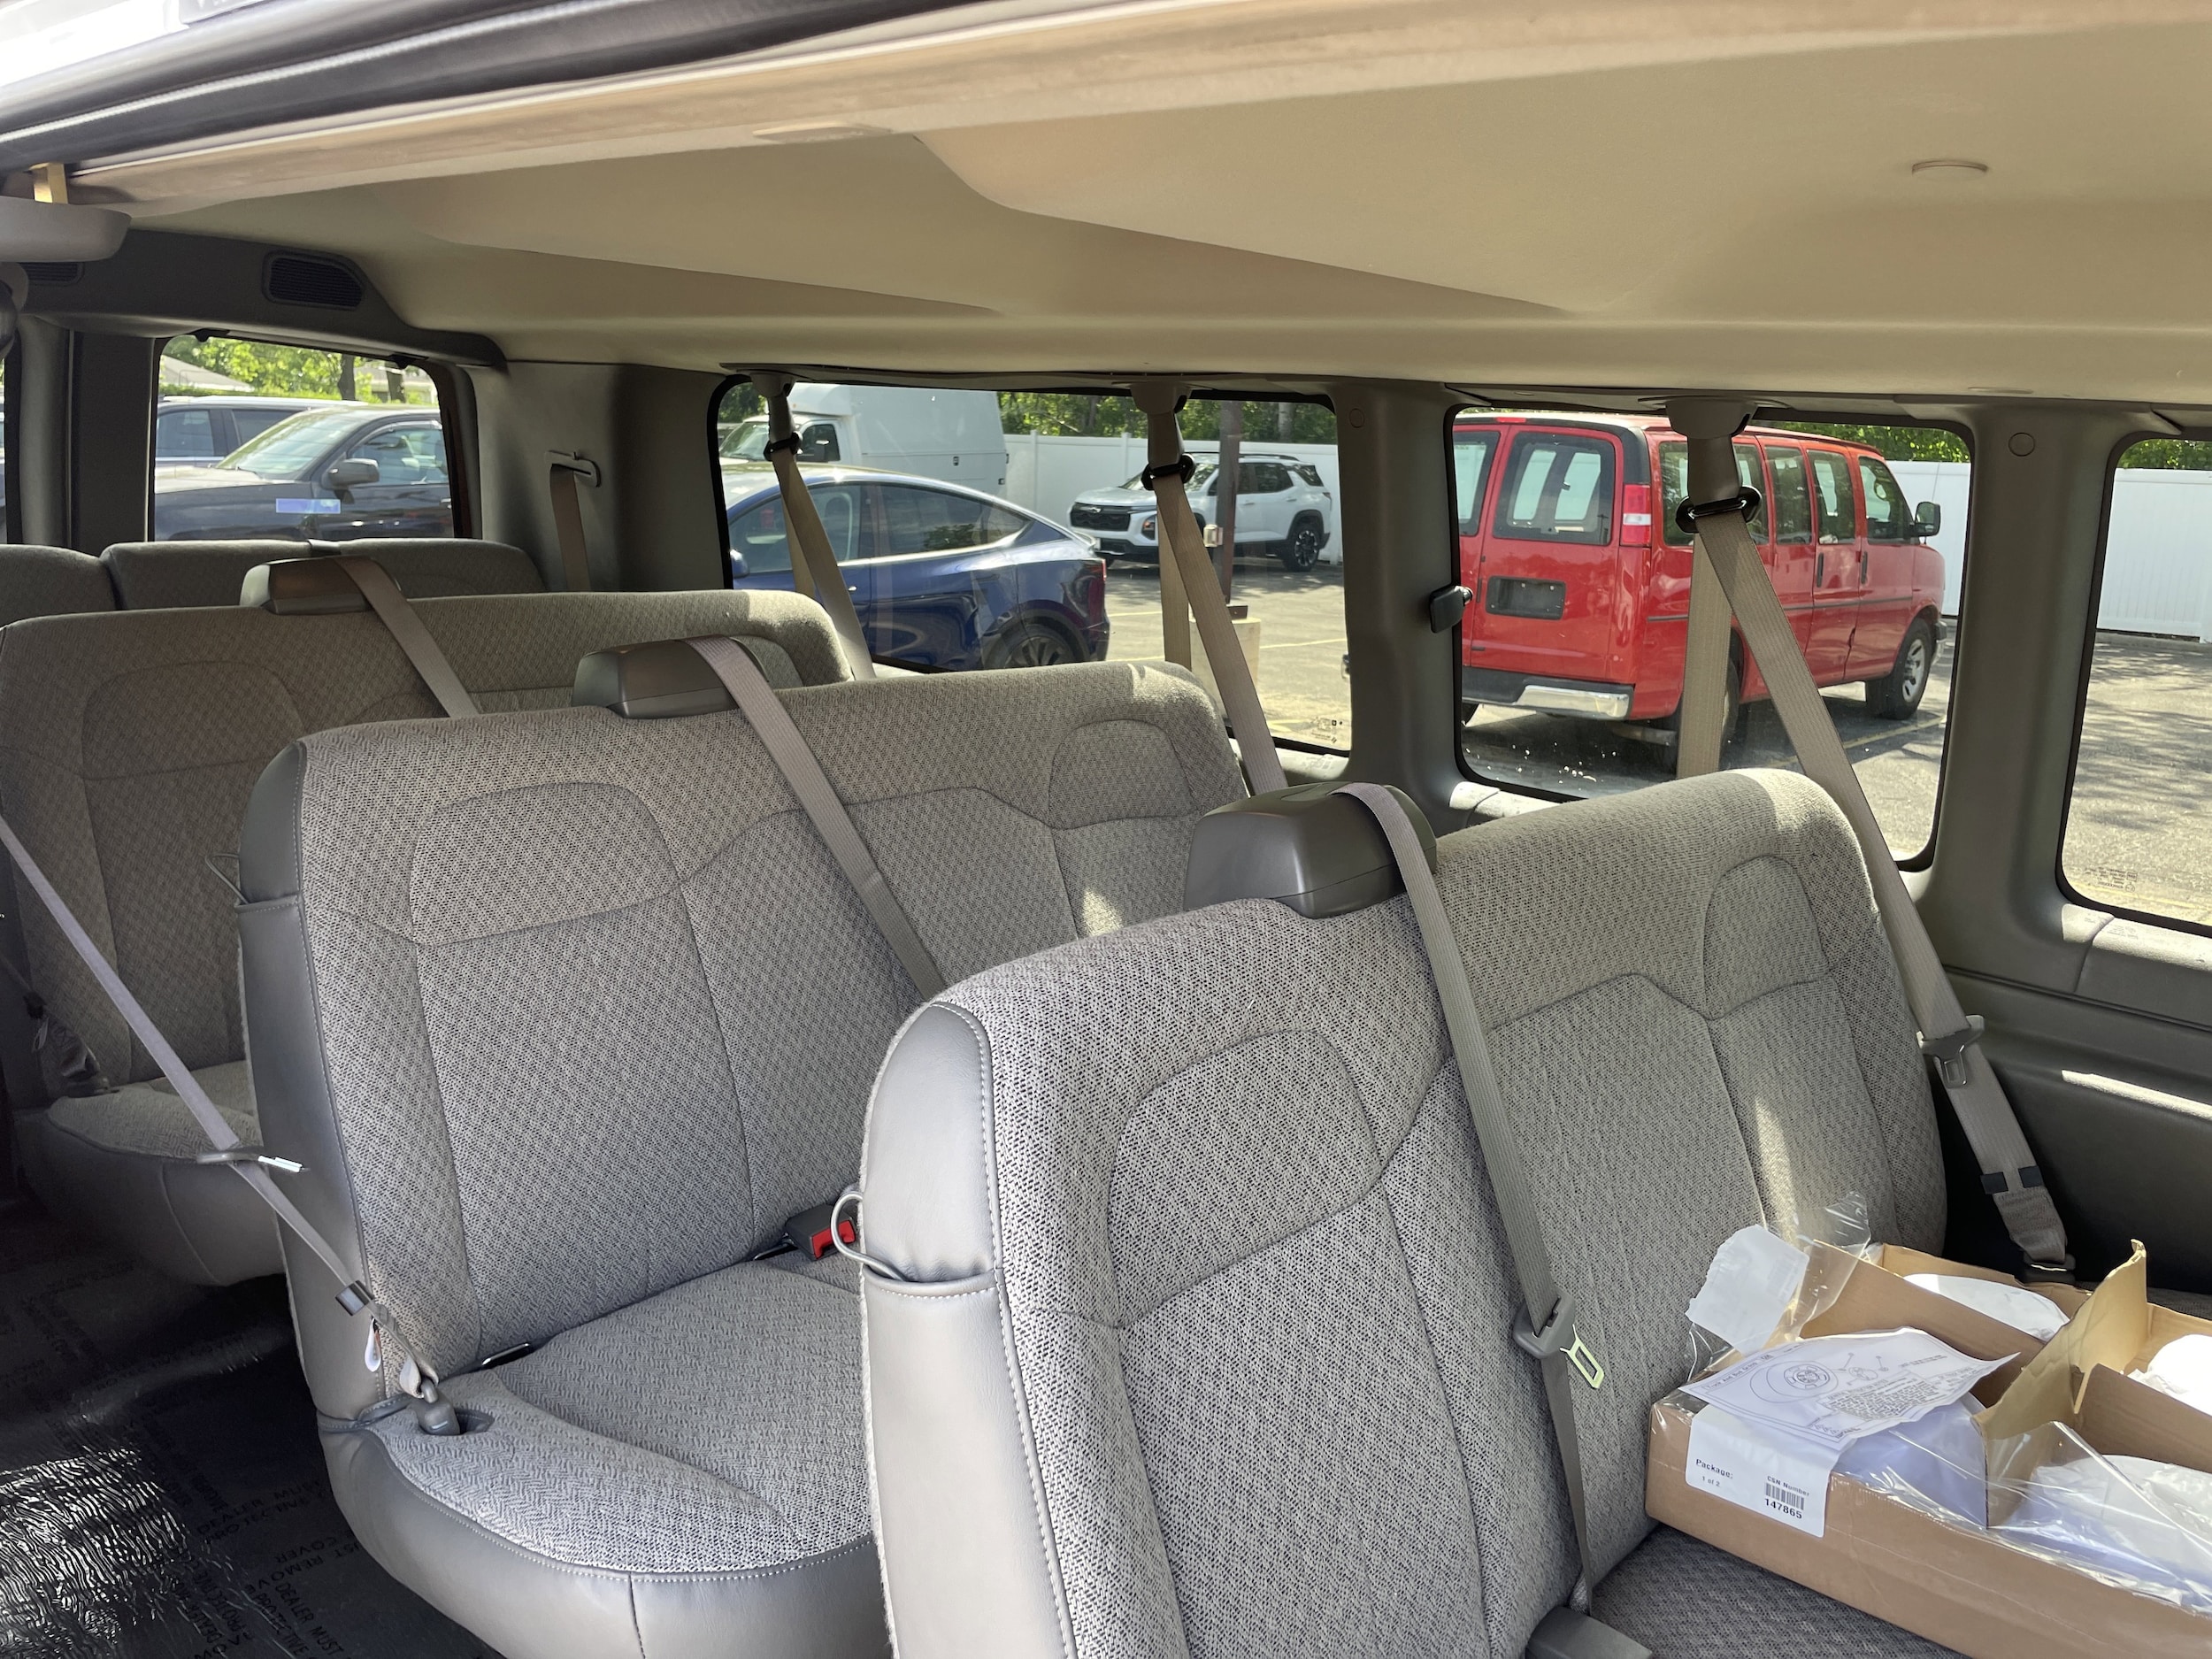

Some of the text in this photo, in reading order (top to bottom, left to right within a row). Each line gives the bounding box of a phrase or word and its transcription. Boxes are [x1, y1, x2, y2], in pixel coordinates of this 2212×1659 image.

[1767, 1475, 1809, 1496] CSN Number
[196, 1498, 265, 1535] DEALER
[1764, 1498, 1802, 1519] 147865
[273, 1536, 337, 1563] COVER
[244, 1555, 324, 1594] REMOVE
[274, 1582, 345, 1655] DEALER MUST
